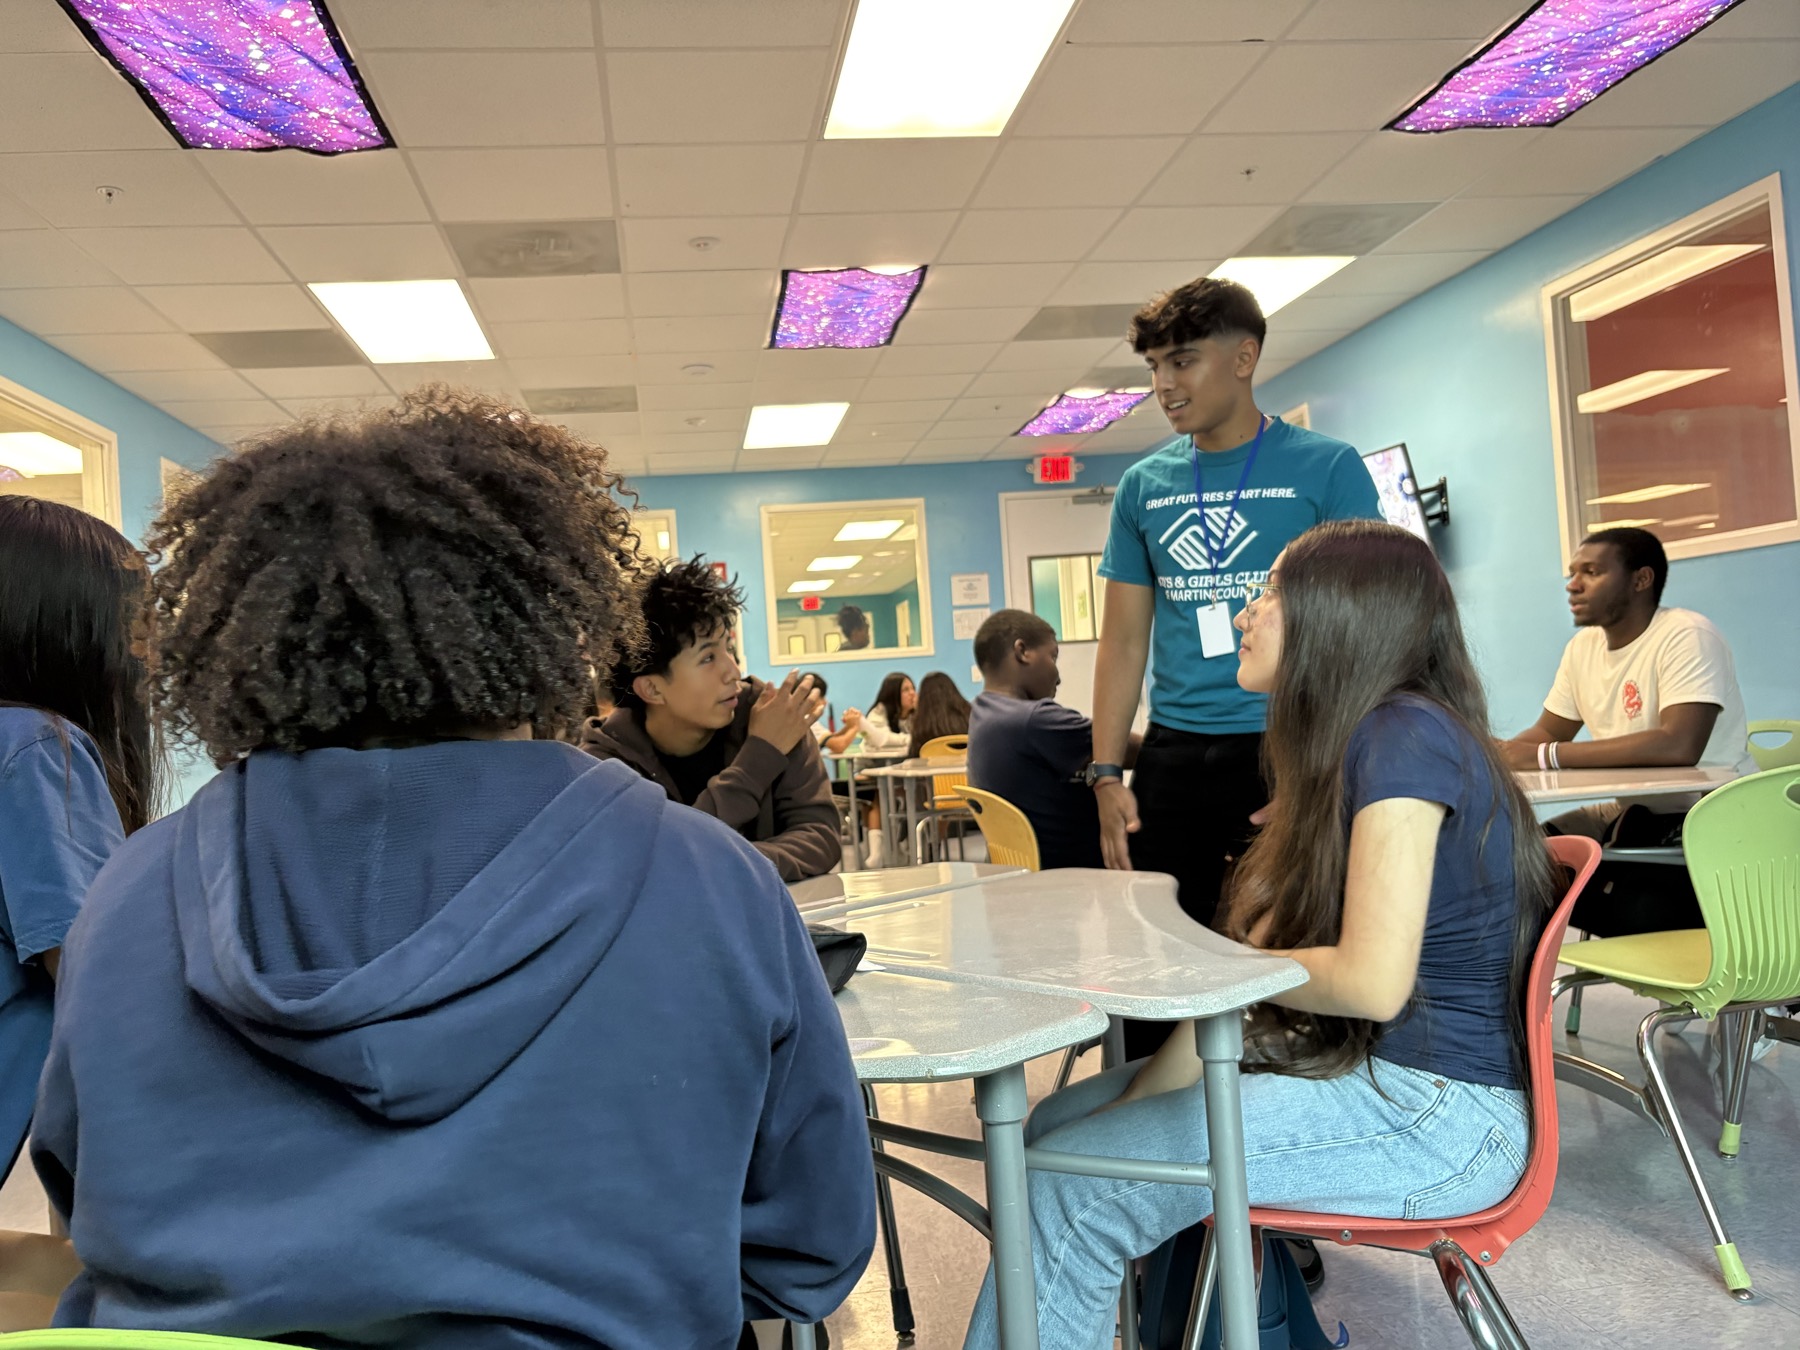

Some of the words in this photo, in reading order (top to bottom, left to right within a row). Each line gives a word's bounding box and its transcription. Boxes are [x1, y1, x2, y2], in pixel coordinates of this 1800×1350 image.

[1145, 495, 1175, 511] GREAT
[1262, 487, 1297, 499] HERE.
[1174, 575, 1185, 589] &
[1187, 573, 1233, 588] GIRLS
[1170, 588, 1212, 602] MARTIN
